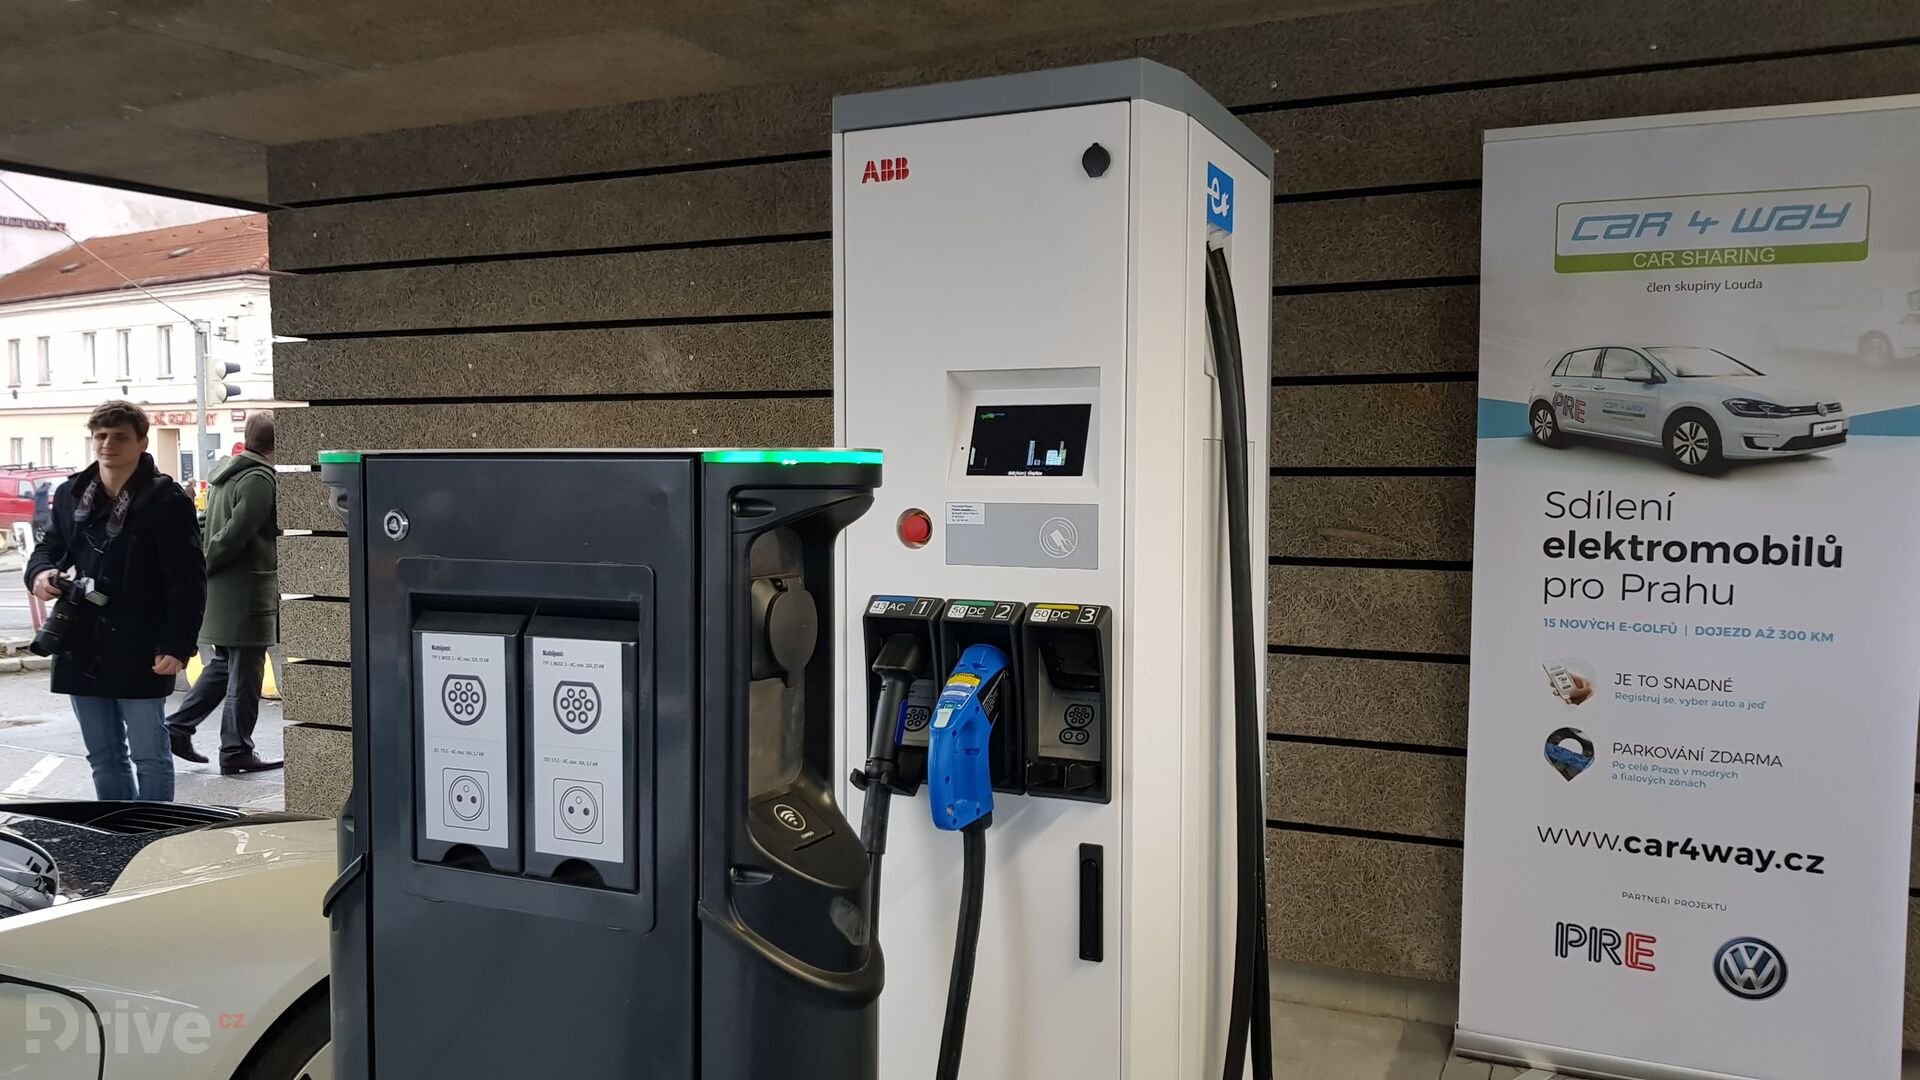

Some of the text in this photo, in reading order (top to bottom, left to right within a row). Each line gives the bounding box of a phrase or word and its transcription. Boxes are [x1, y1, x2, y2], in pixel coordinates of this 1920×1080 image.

[862, 156, 910, 184] ABB
[1688, 210, 1719, 234] 4
[1633, 248, 1776, 268] CAR SHARING
[1646, 279, 1763, 293] člen skupiny Louda
[1552, 391, 1586, 424] PRE
[1544, 490, 1676, 521] Sdílení
[1543, 531, 1843, 567] elektromobilů
[1544, 574, 1735, 605] pro Prahu
[919, 601, 928, 614] 1
[995, 605, 1011, 618] 2
[1080, 608, 1095, 622] 3
[1543, 618, 1834, 642] 15 NOVÝCH E-GOLFŮ DOJEZD AŽ 300 KM
[1614, 673, 1733, 693] JE TO SNADNÉ
[1615, 692, 1660, 705] Registruj
[1679, 697, 1708, 709] vyber
[1712, 699, 1736, 708] auto
[1613, 743, 1783, 768] PARKOVÁNÍ ZDARMA
[1612, 761, 1625, 770] Po
[1651, 764, 1679, 775] Praze
[1691, 768, 1738, 780] modrých
[1620, 773, 1666, 786] fialových
[1669, 777, 1706, 788] zónách
[1537, 825, 1825, 874] www.car4way.cz
[1622, 891, 1727, 912] PARTNEŘI PROJEKTU
[1555, 921, 1657, 972] PRE
